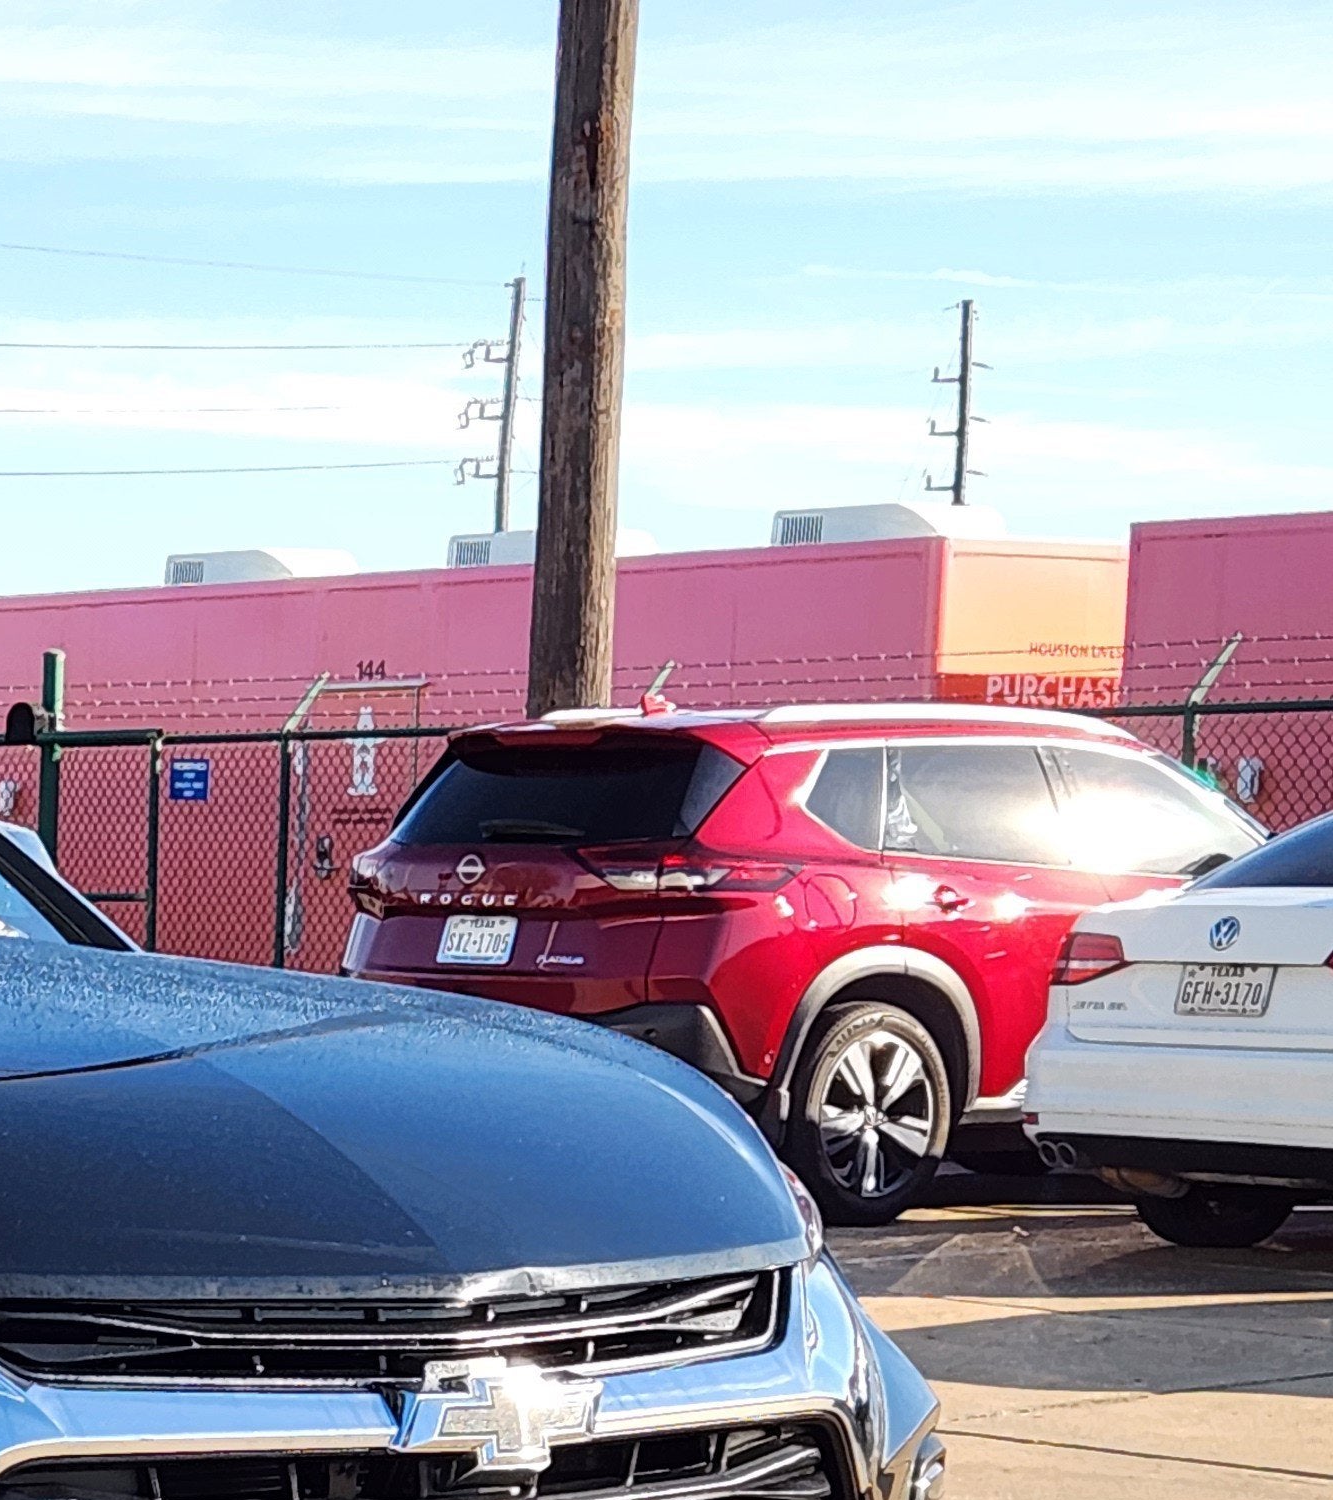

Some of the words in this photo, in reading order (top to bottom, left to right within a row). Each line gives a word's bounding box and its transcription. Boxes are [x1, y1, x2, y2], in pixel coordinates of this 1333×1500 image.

[1029, 643, 1088, 657] HOUSTON
[356, 660, 385, 681] 144
[419, 893, 518, 906] ROGUE
[1211, 966, 1245, 977] TEXAS
